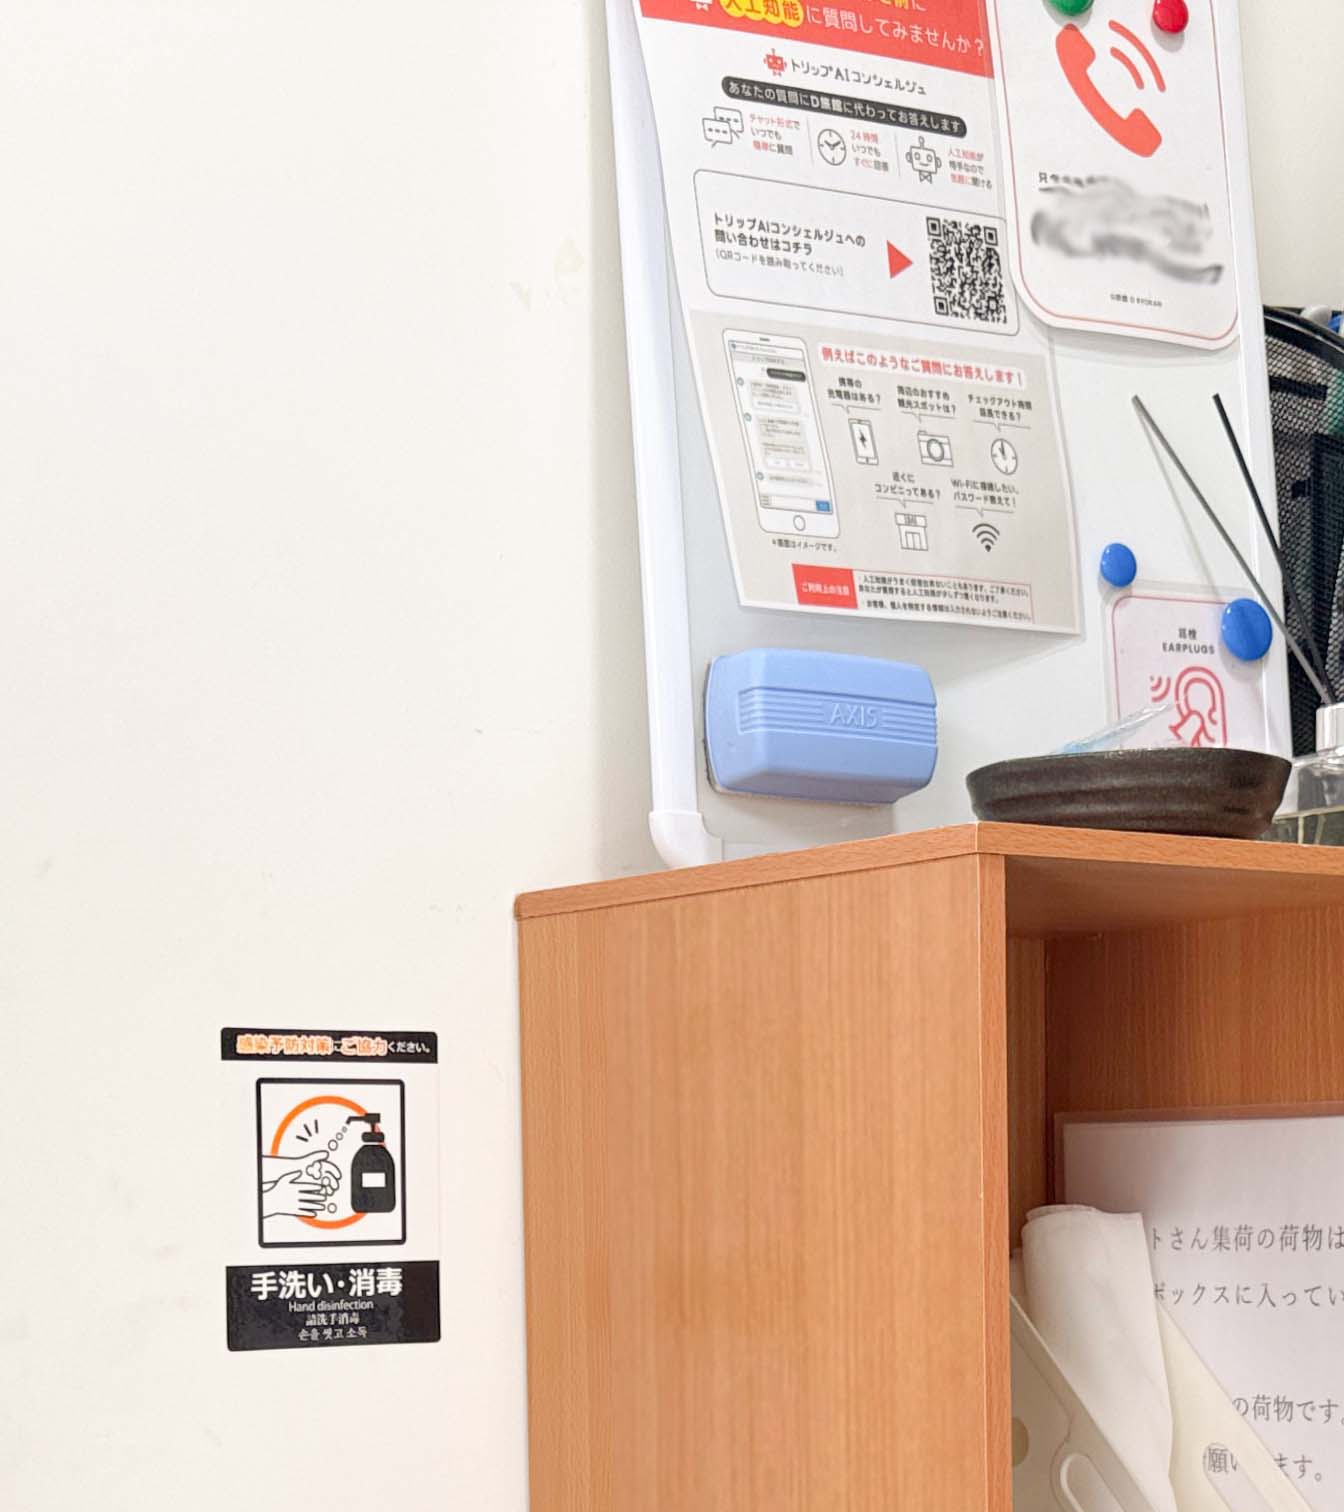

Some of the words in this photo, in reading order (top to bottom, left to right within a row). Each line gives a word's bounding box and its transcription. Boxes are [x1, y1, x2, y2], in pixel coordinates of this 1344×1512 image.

[791, 58, 927, 96] トリップAIコンシェルジュ
[728, 81, 962, 135] あなたの質問にD旅館に代わってお答えします
[714, 212, 866, 248] トリップAIコンシェルジュへの
[714, 228, 813, 256] 問い合わせはコチラ
[1177, 627, 1198, 641] 耳栓
[1162, 643, 1216, 656] EARPLUGS
[829, 703, 878, 729] AXIS
[250, 1266, 404, 1301] 手洗い・消毒
[288, 1299, 315, 1313] Hand
[316, 1298, 374, 1312] disinfection
